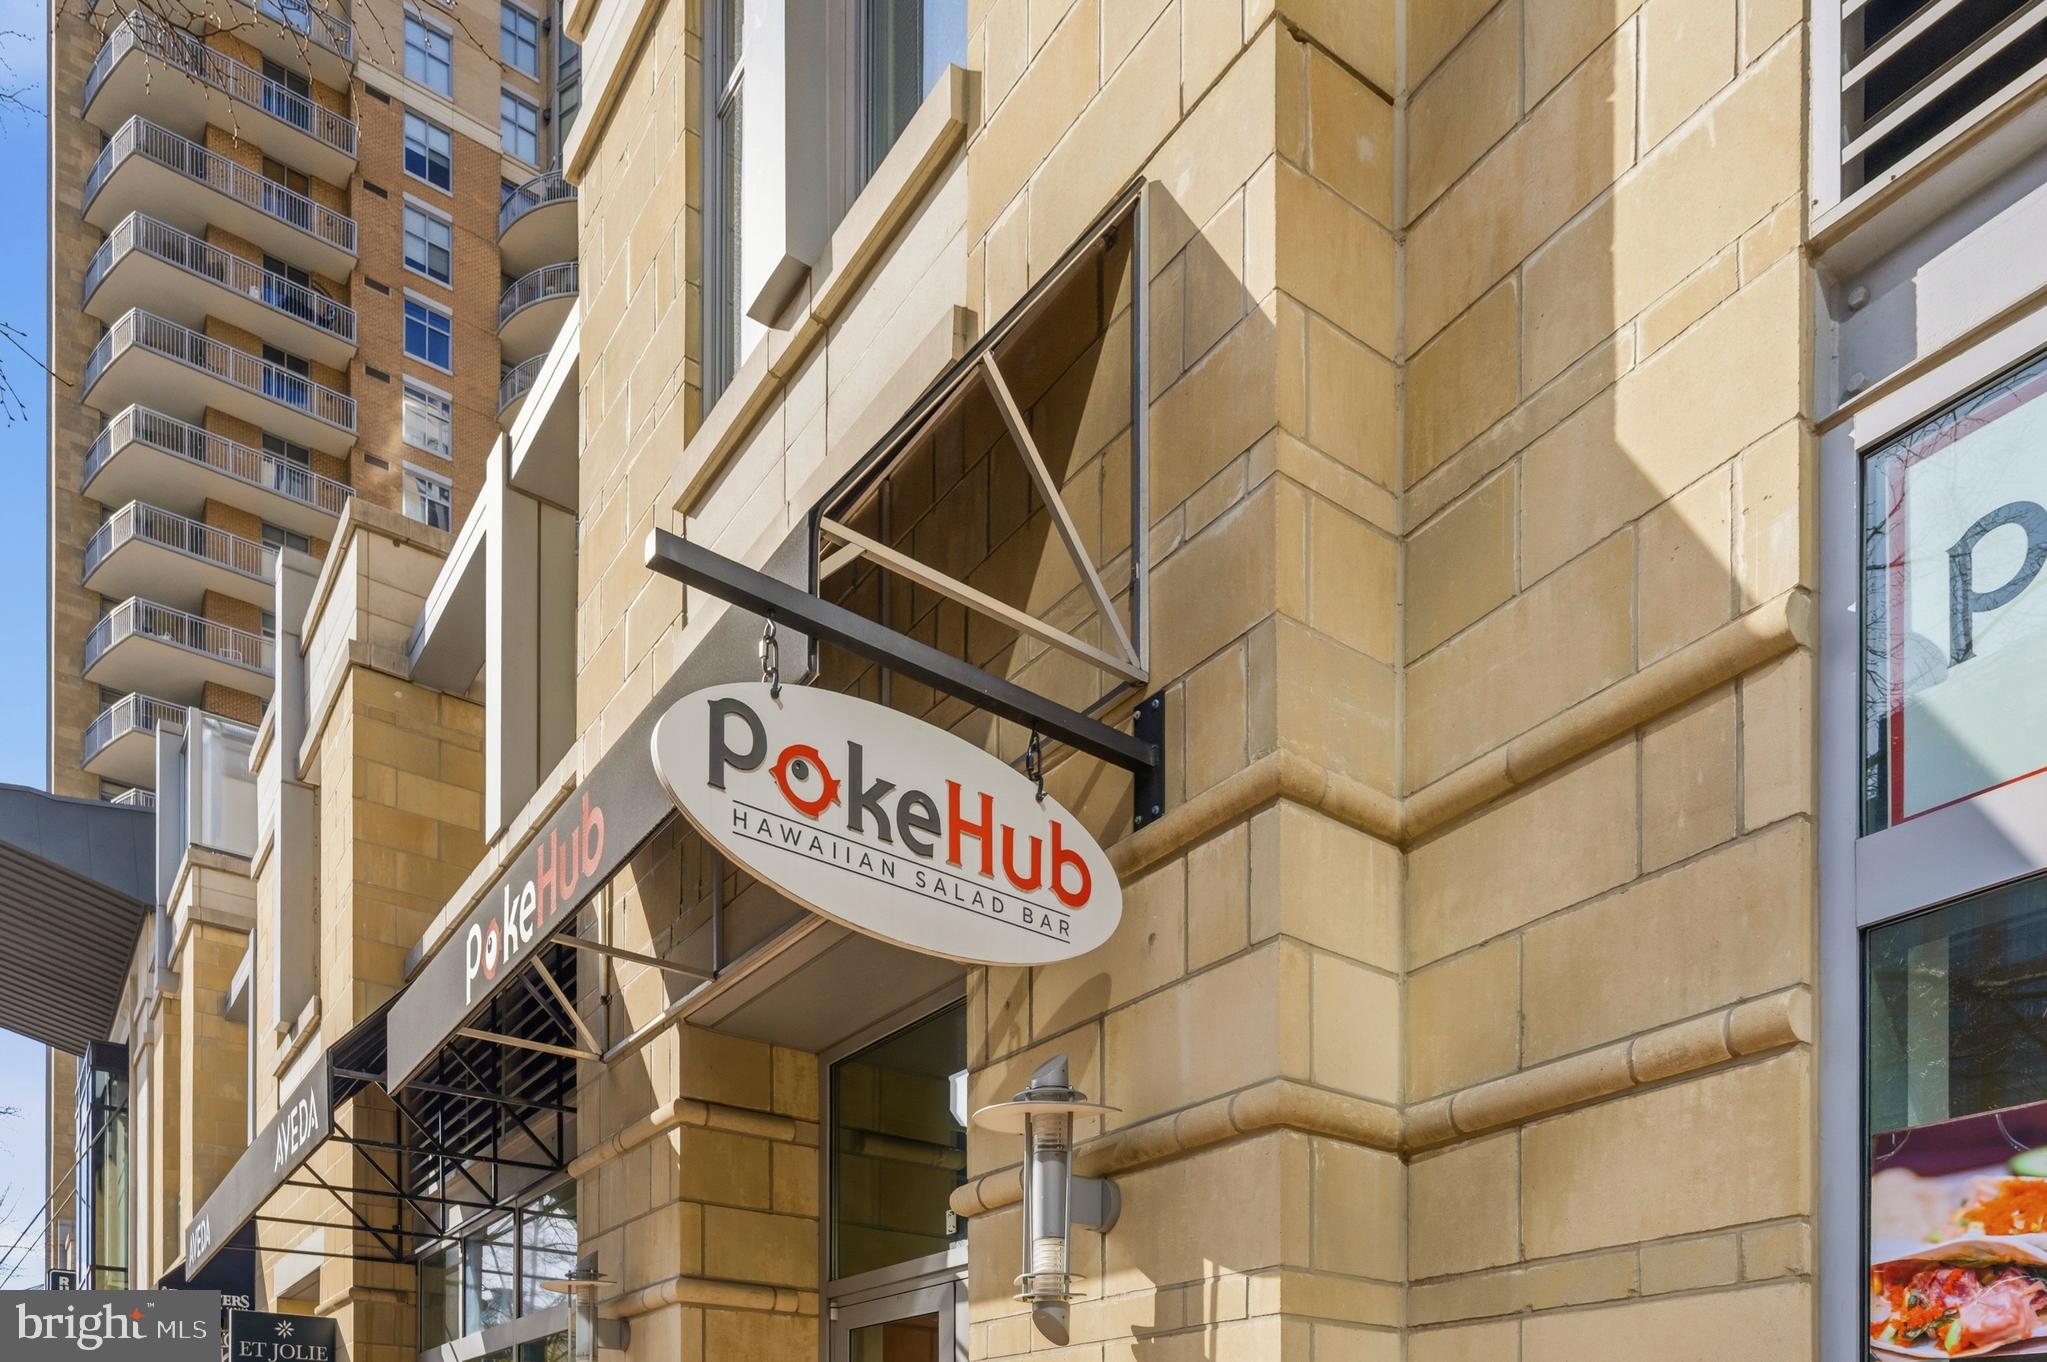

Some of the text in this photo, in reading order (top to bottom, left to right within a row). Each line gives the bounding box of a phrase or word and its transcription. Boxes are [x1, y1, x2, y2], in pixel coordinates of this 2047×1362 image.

[707, 698, 1092, 908] PokeHub
[733, 808, 1071, 938] HAWAIIAN SALAD BAR
[274, 1086, 319, 1172] AVEDA
[189, 1213, 211, 1267] AVEDA
[239, 1340, 267, 1357] ET
[268, 1343, 328, 1362] JOLIE
